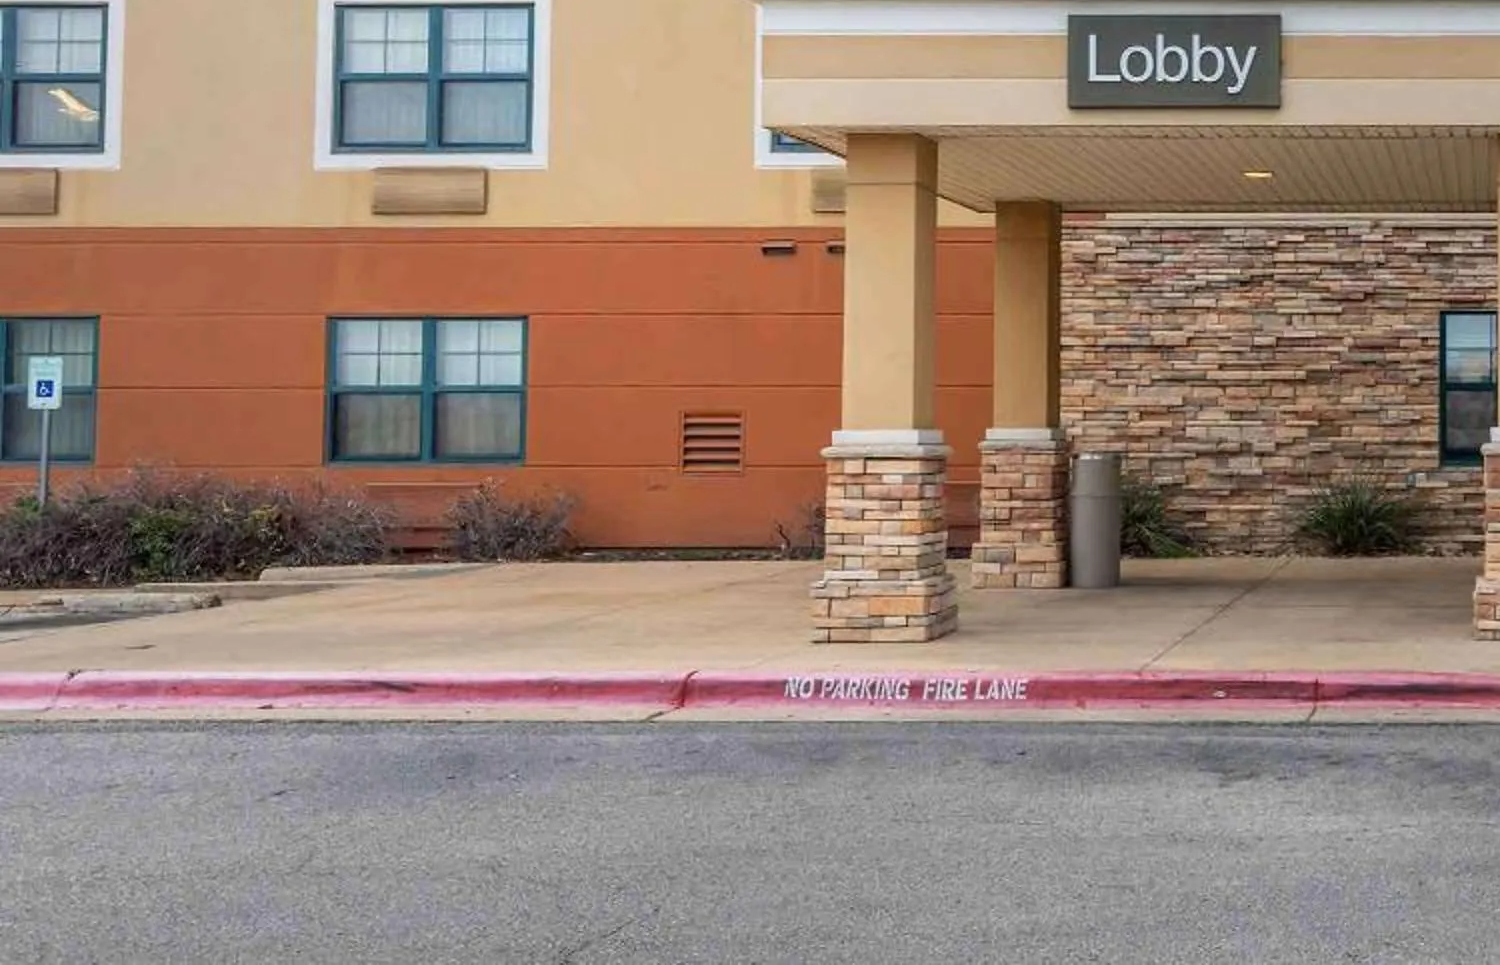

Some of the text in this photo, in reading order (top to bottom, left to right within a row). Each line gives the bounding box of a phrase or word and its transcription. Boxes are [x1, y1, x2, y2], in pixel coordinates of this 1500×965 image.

[1087, 33, 1257, 94] Lobby
[783, 676, 1029, 700] NO PARKING FIRE LANE
